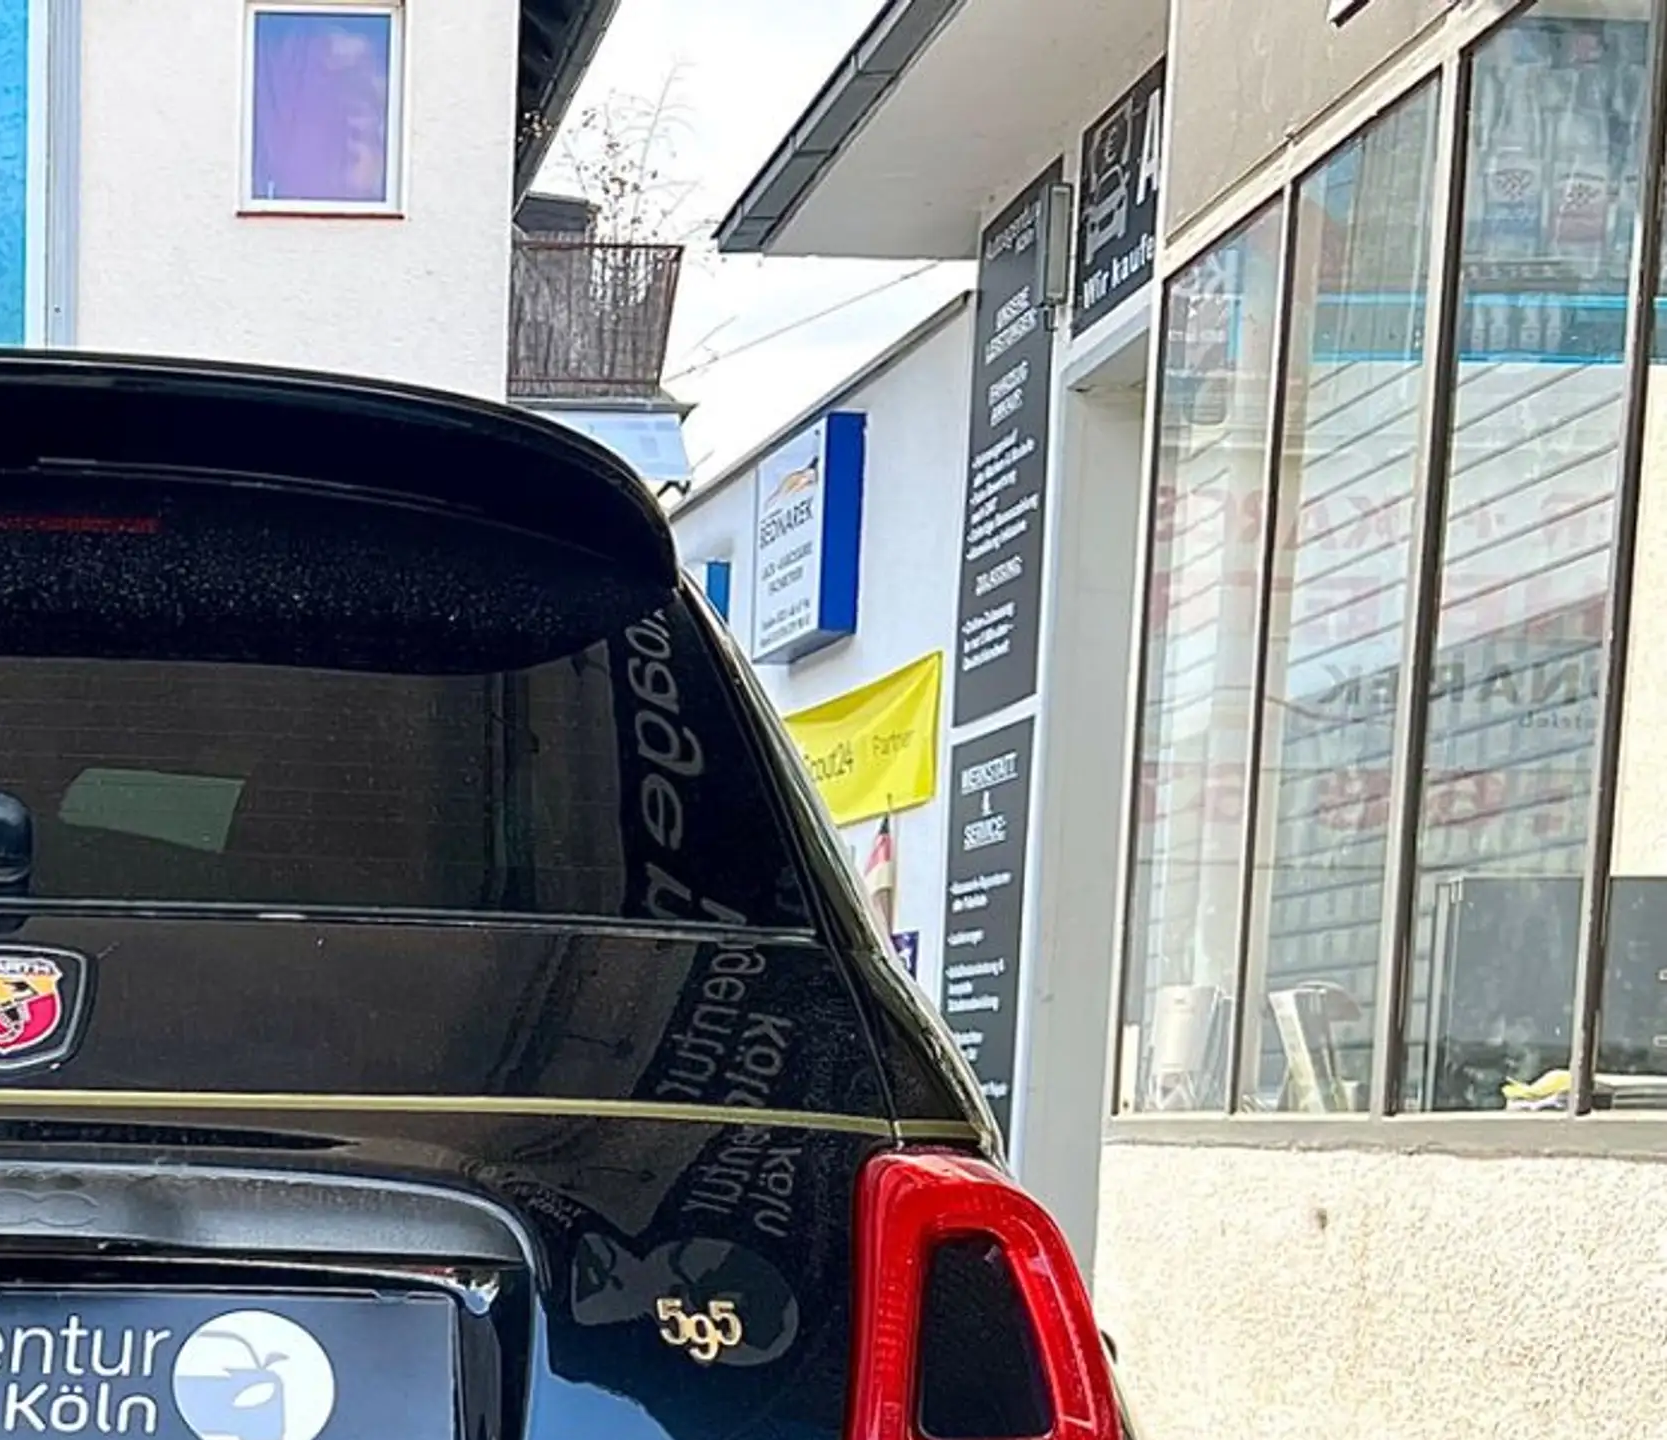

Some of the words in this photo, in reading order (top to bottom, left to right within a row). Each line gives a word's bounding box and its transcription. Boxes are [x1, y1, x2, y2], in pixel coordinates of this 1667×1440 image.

[1084, 269, 1110, 309] Wir
[657, 1299, 742, 1362] 595
[1, 1379, 160, 1436] Köln
